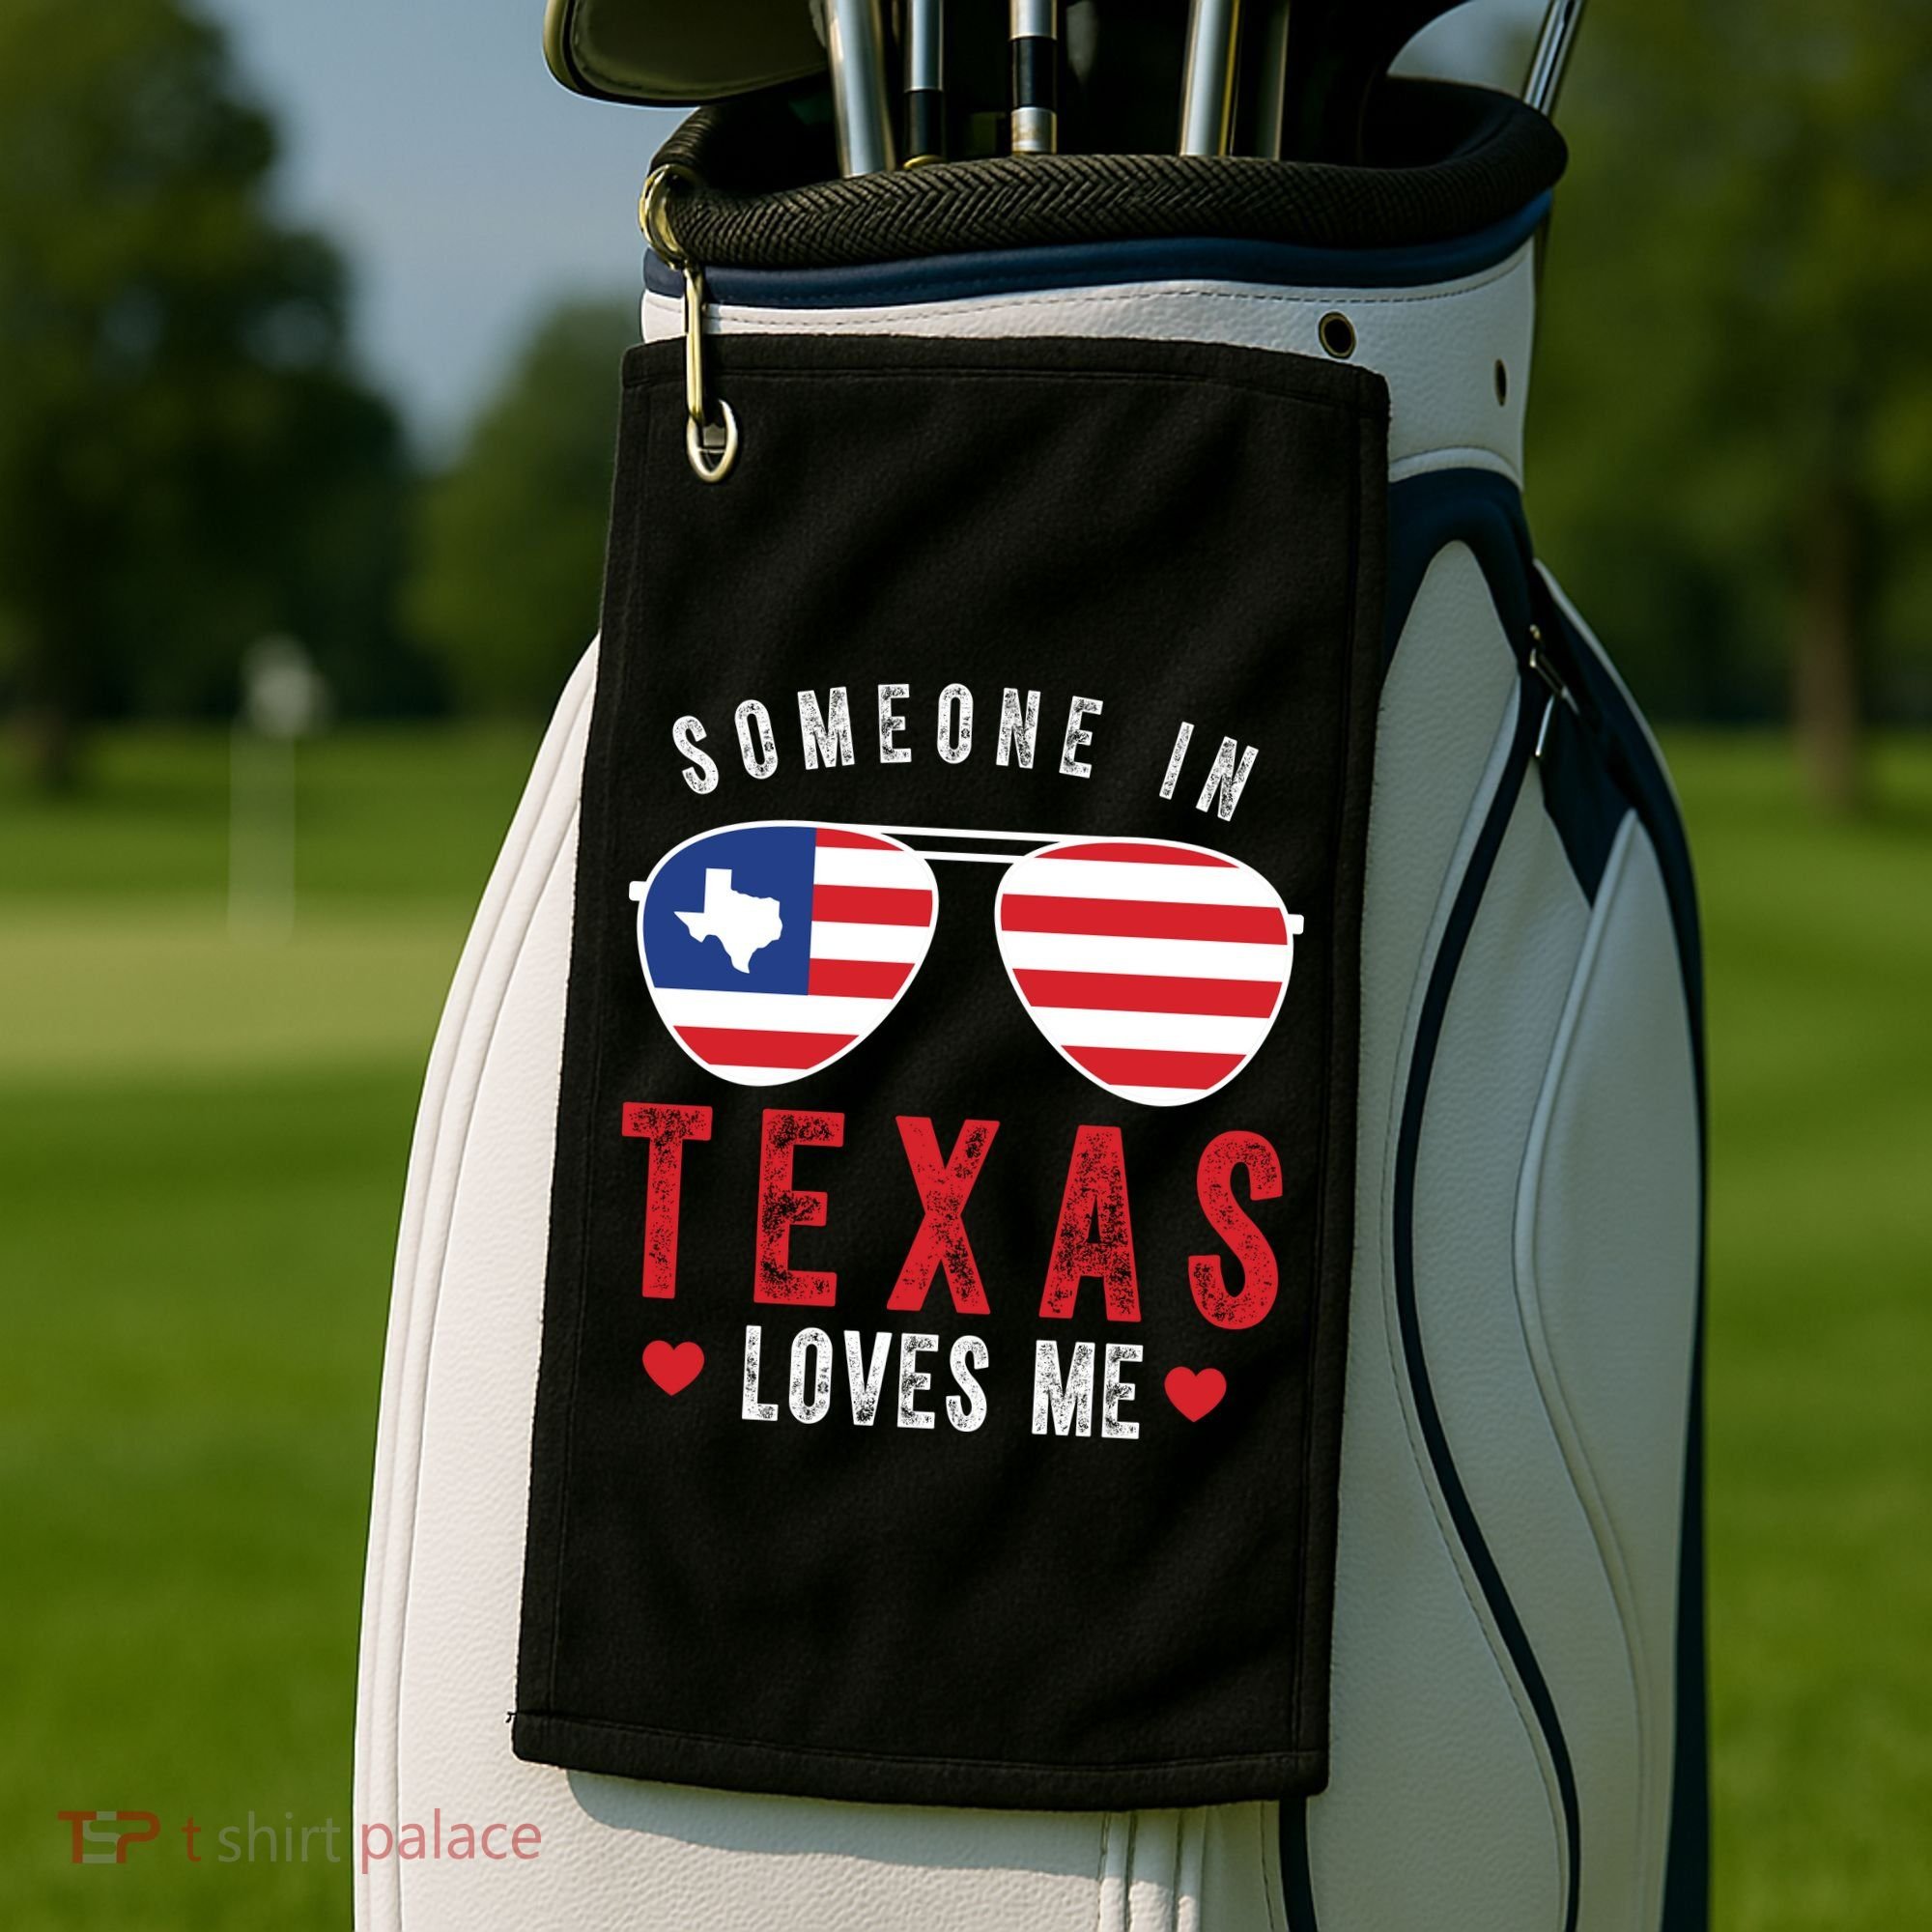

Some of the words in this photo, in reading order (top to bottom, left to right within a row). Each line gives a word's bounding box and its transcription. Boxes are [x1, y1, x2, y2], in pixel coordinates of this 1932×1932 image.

[672, 684, 1103, 794] SOMEONE
[1159, 722, 1259, 821] IN
[622, 1102, 1282, 1329] TEXAS
[742, 1325, 988, 1432] LOVES
[1032, 1340, 1143, 1439] ME
